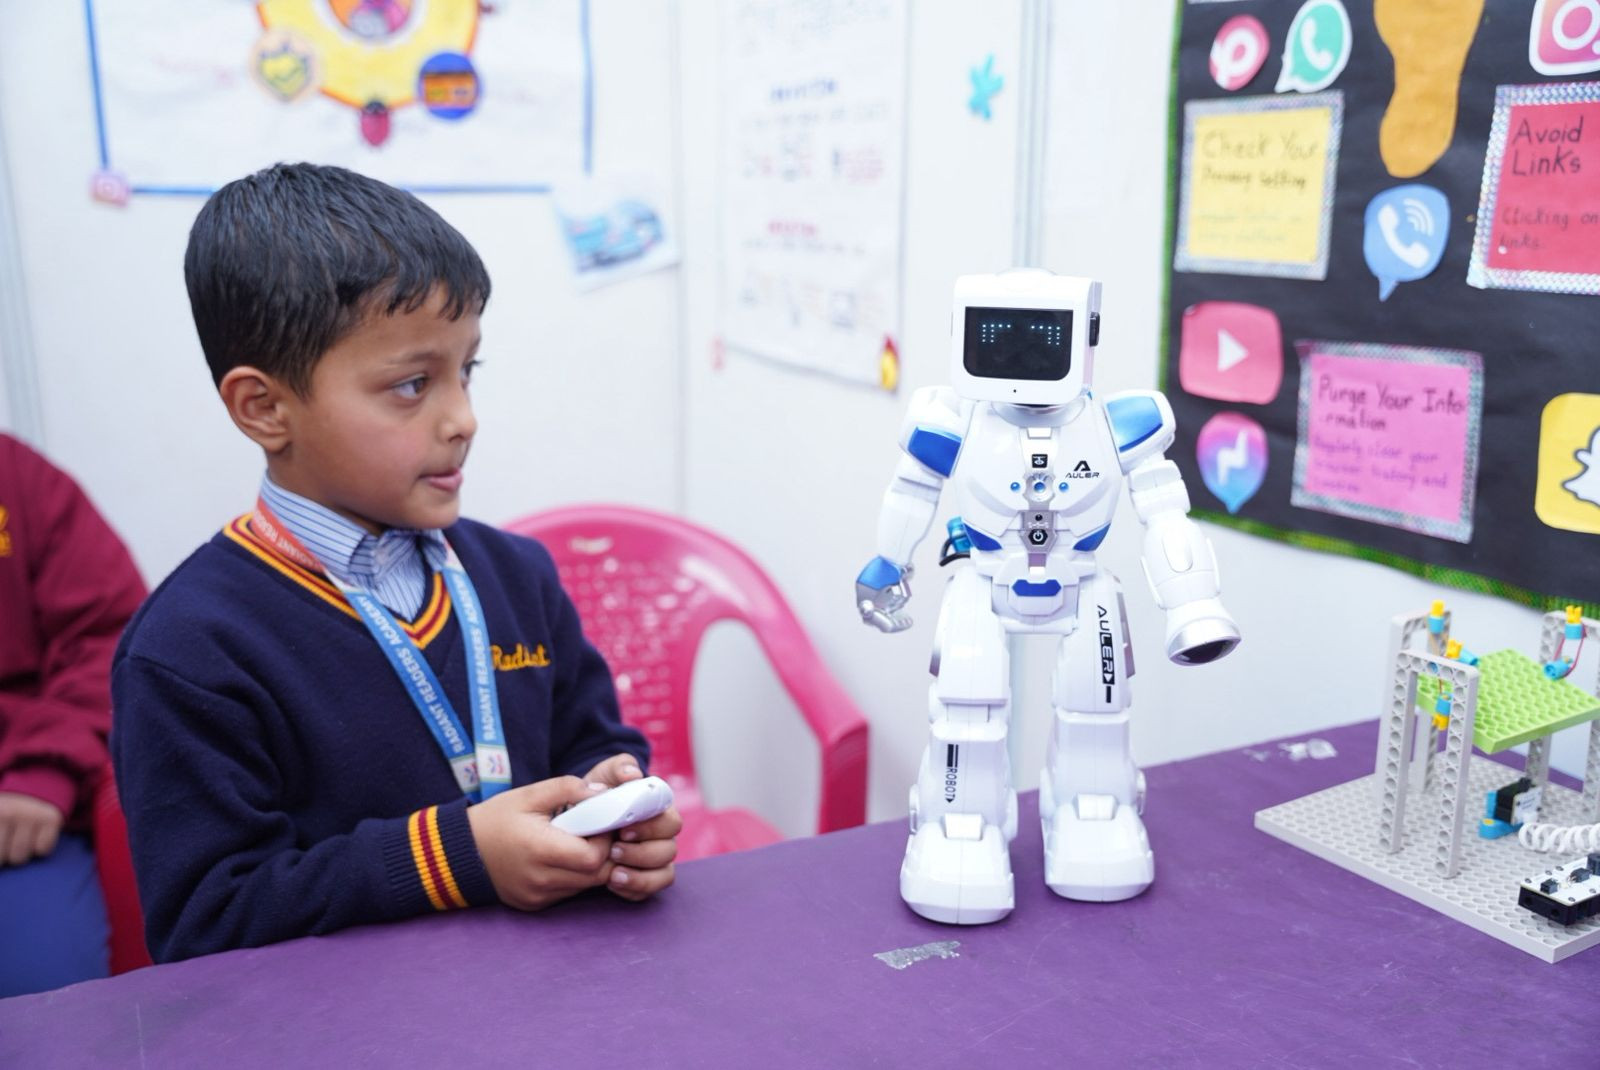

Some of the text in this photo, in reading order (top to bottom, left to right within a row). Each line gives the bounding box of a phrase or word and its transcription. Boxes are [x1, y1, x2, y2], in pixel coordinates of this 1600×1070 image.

[1202, 128, 1271, 159] Check
[1513, 115, 1584, 144] Avoid
[1512, 146, 1581, 176] Links
[1318, 374, 1366, 411] Purge
[1376, 381, 1414, 410] Your
[357, 596, 403, 646] ACADEMY
[1097, 604, 1114, 674] AULER
[428, 702, 466, 754] RADIANT
[477, 686, 497, 742] RADIANT
[944, 767, 958, 800] ROBOT
